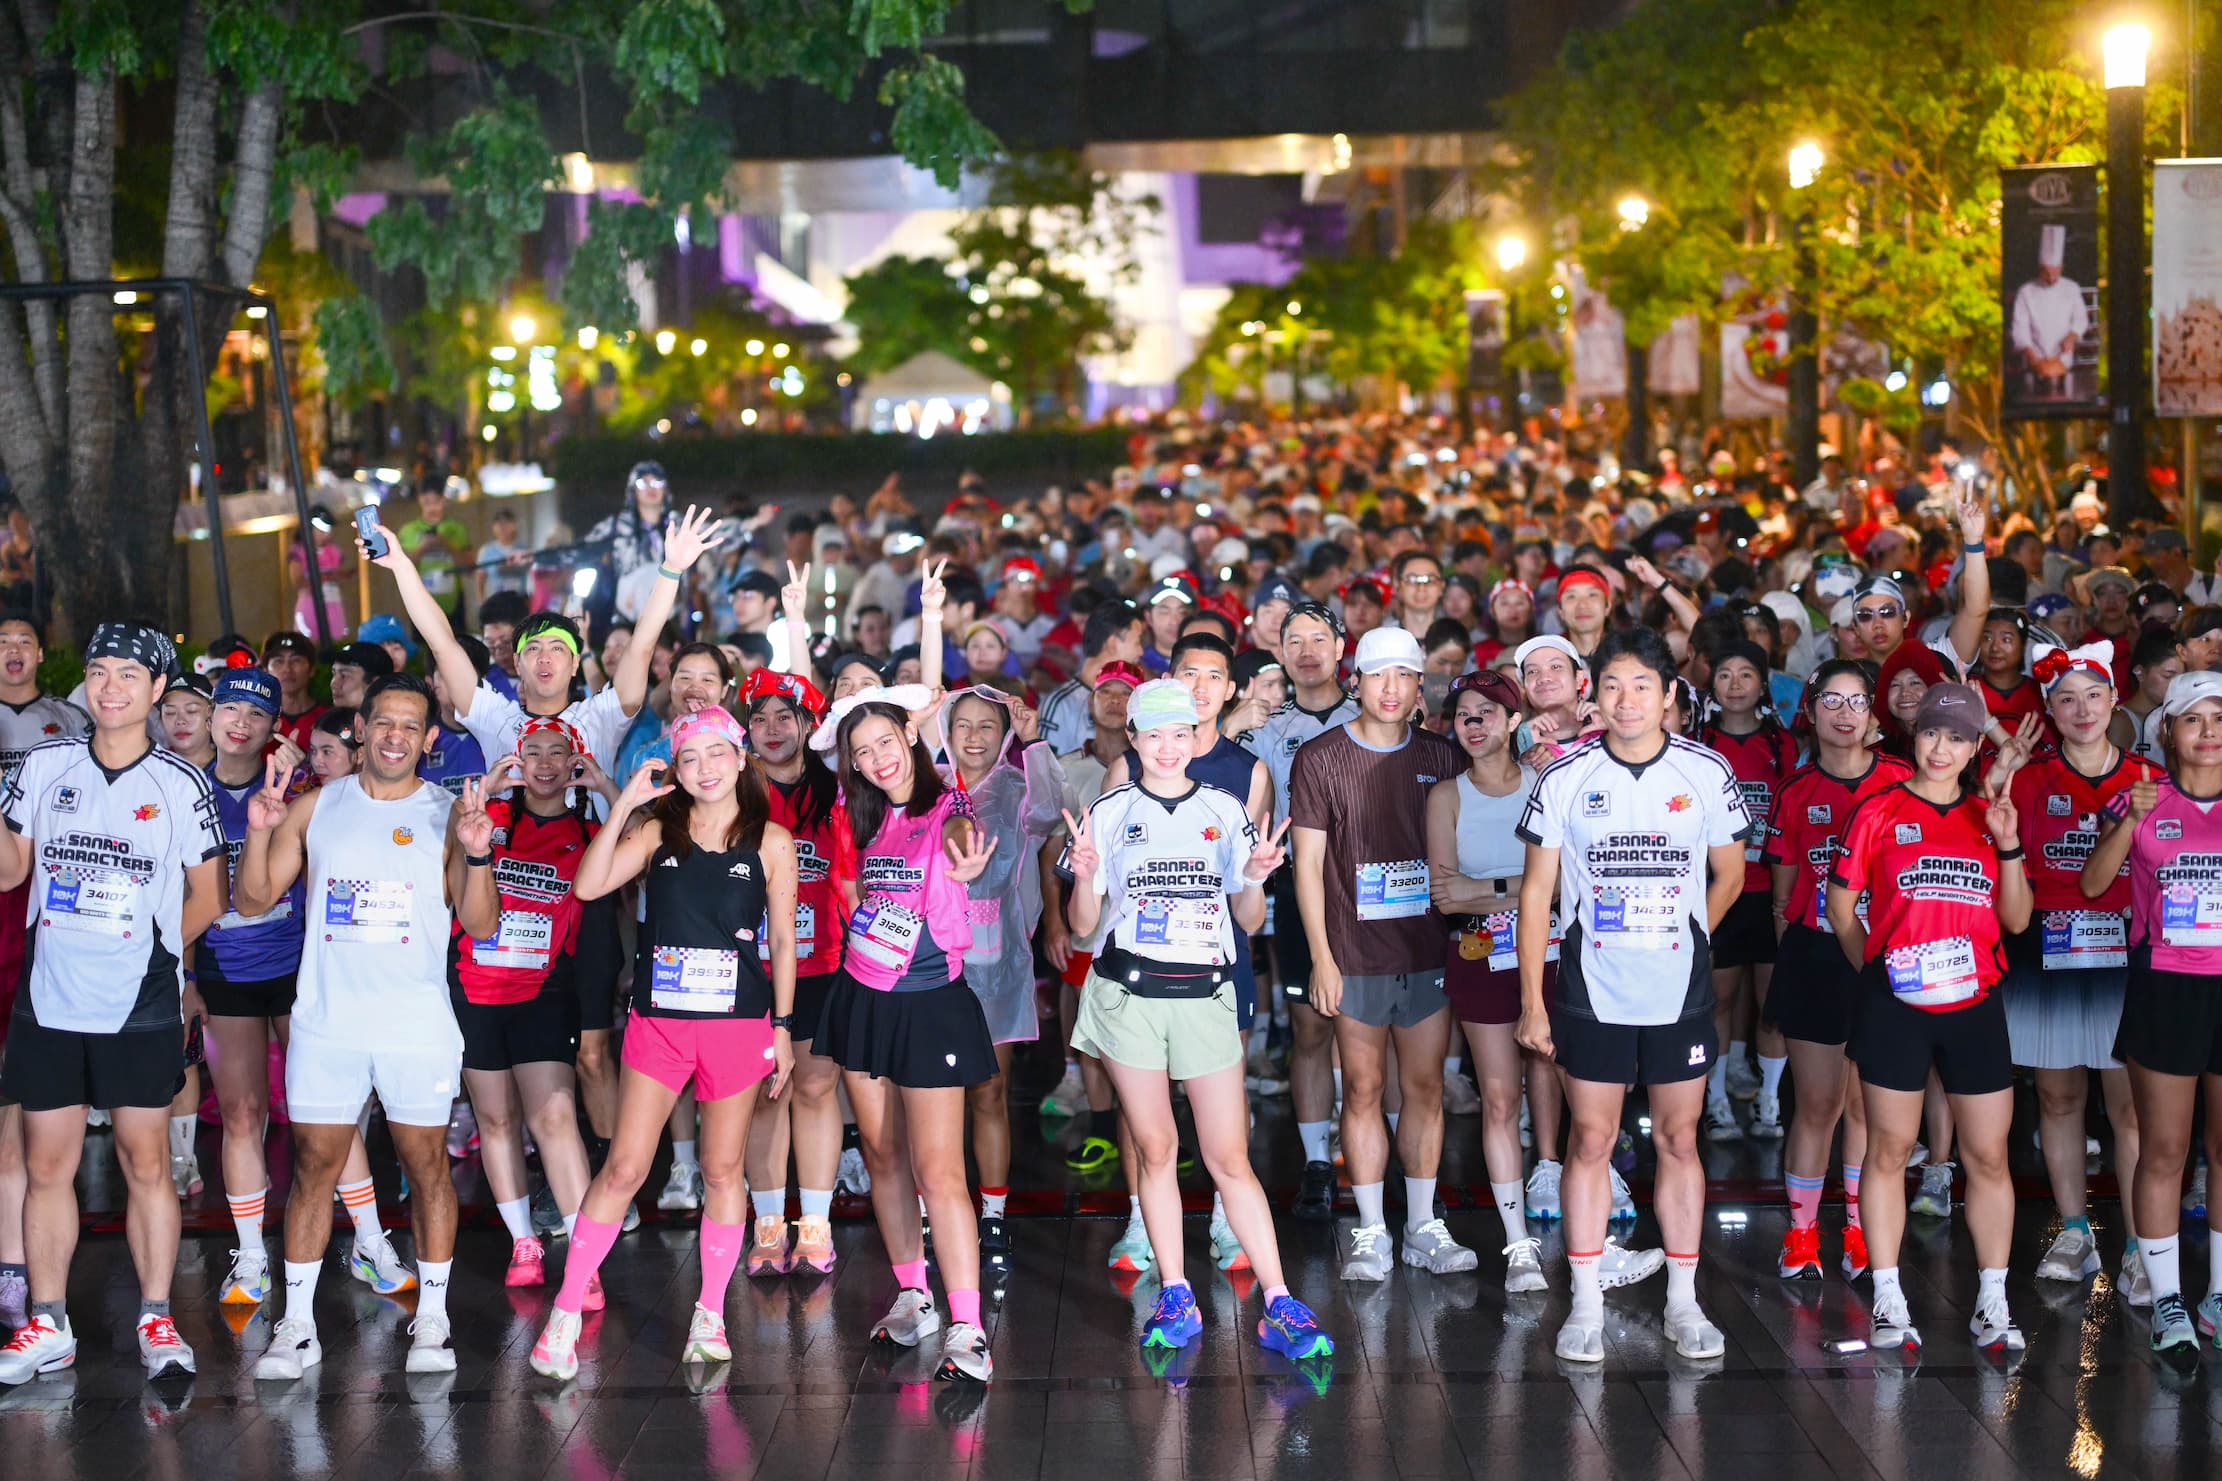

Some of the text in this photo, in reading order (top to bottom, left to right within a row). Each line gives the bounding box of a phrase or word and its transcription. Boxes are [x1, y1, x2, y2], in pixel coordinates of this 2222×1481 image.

[229, 680, 271, 698] THAILAND
[43, 846, 154, 872] CHARACTERS
[1587, 849, 1690, 862] CHARACTERS
[864, 870, 922, 880] ARACTERS
[1389, 876, 1425, 888] 33200
[1360, 884, 1383, 895] 10K
[52, 889, 77, 902] 10K
[85, 889, 129, 902] 34107
[1938, 892, 1979, 902] MARATHON
[330, 903, 352, 913] 10K
[2167, 906, 2195, 919] 10K
[1598, 910, 1623, 921] 10K
[878, 918, 911, 938] 31260
[1140, 922, 1165, 933] 10K
[2076, 927, 2120, 937] 30536
[505, 928, 546, 939] 30030
[2046, 933, 2069, 944] 10K
[1927, 954, 1969, 972] 30725
[656, 970, 680, 981] 10K
[1894, 970, 1920, 984] 10K
